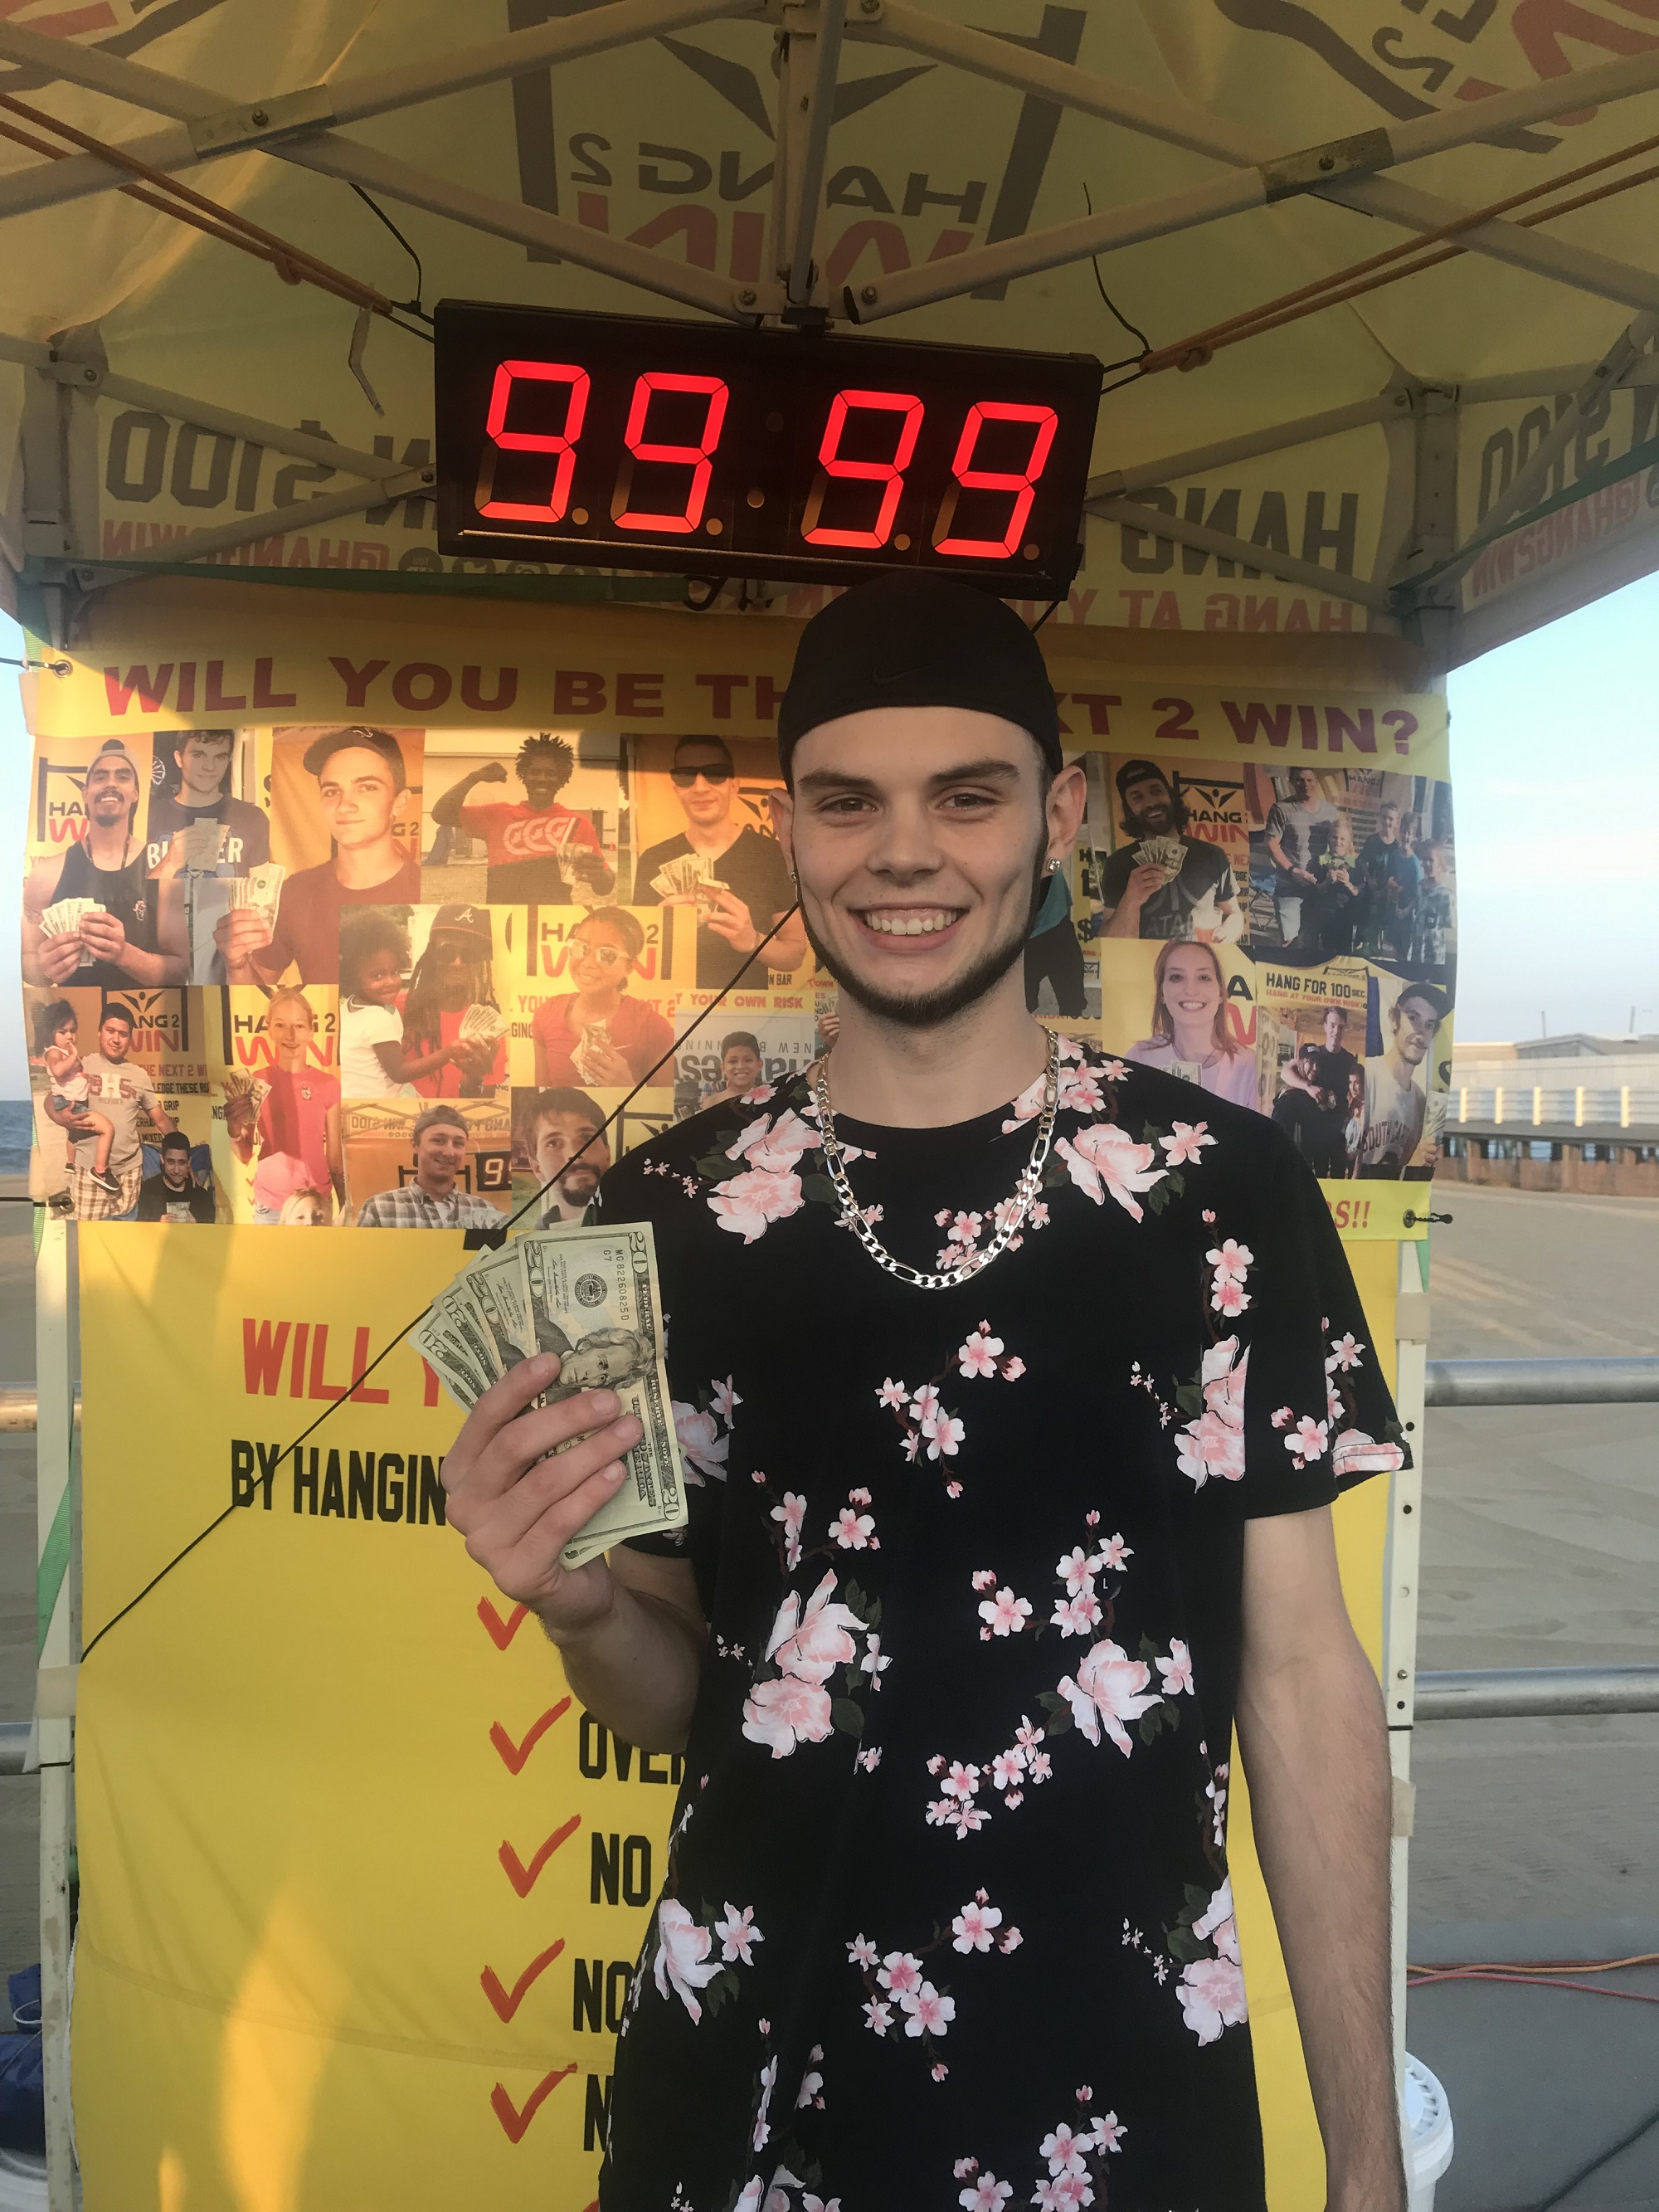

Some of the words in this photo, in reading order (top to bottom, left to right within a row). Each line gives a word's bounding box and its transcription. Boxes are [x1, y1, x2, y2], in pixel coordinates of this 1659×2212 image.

[104, 658, 296, 715] WILL
[328, 656, 518, 712] YOU
[553, 670, 664, 718] BE
[696, 675, 785, 720] TH
[1152, 698, 1199, 741] 2
[1220, 700, 1419, 756] WIN?
[776, 974, 792, 986] BAR
[1267, 972, 1301, 991] HANG
[1304, 978, 1326, 996] FOR
[1331, 983, 1351, 998] 100
[690, 995, 727, 1006] YOUR
[734, 996, 766, 1008] OWN
[774, 997, 803, 1009] RISK
[172, 1014, 179, 1027] 2
[324, 1013, 336, 1032] 2
[159, 1065, 184, 1077] NEXT
[188, 1065, 195, 1077] 2
[177, 1083, 198, 1094] THESE
[524, 1240, 547, 1298] 20
[466, 1271, 499, 1325] 20
[243, 1318, 389, 1405] WILL
[231, 1440, 280, 1511] BY
[293, 1445, 448, 1527] HANGIN
[661, 1488, 680, 1521] 20
[591, 1833, 652, 1907] NO
